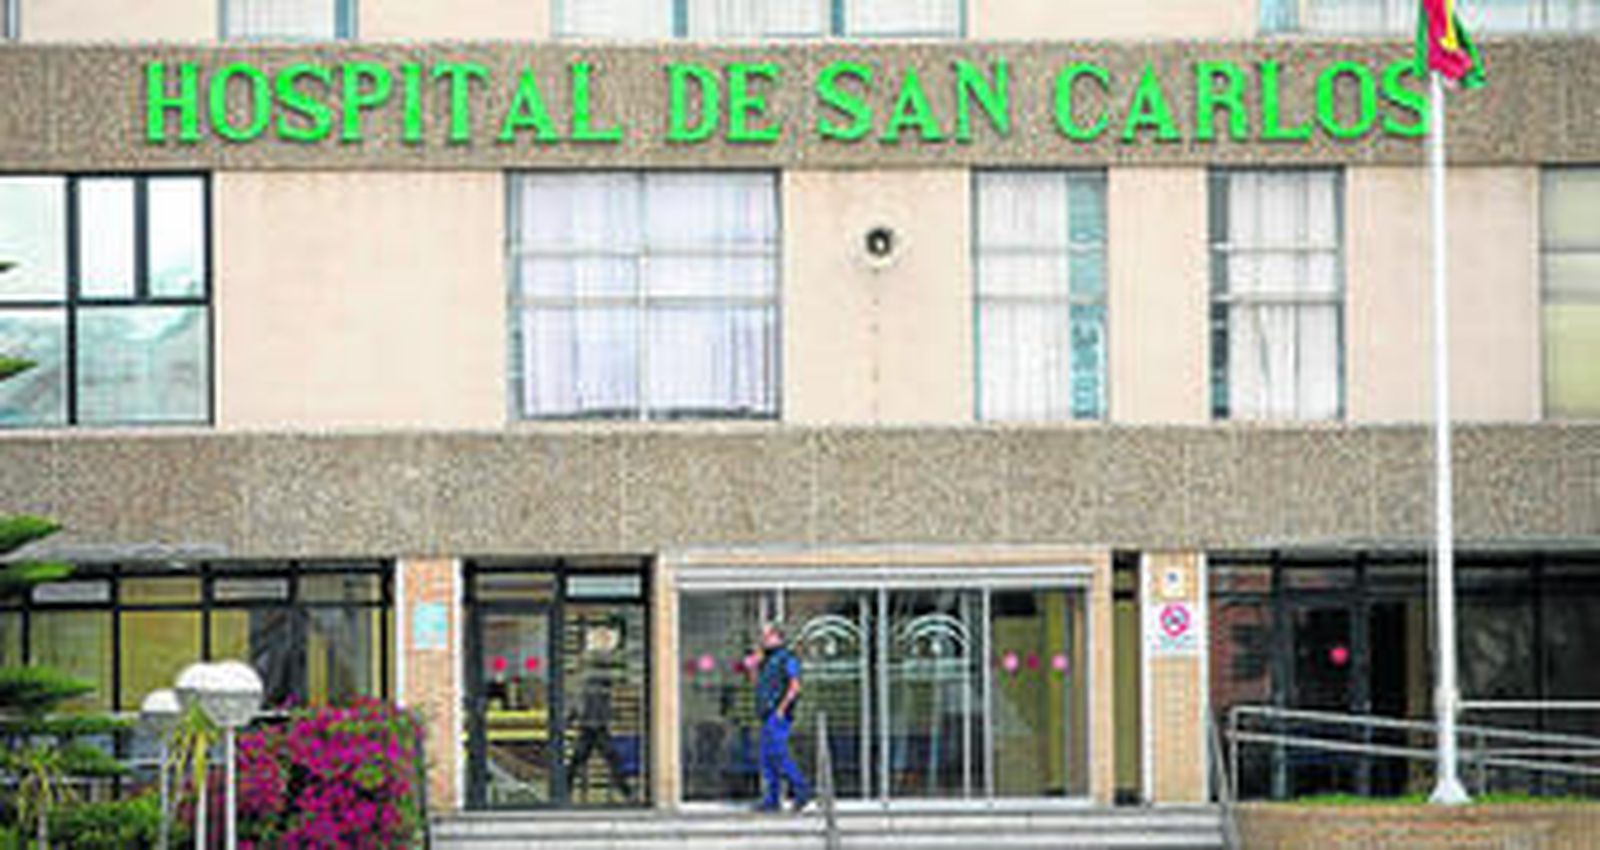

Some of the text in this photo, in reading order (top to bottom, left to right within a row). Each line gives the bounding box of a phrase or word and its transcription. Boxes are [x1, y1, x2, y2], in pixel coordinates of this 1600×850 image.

[143, 58, 1431, 145] HOSPITAL DE SAN CARLOS
